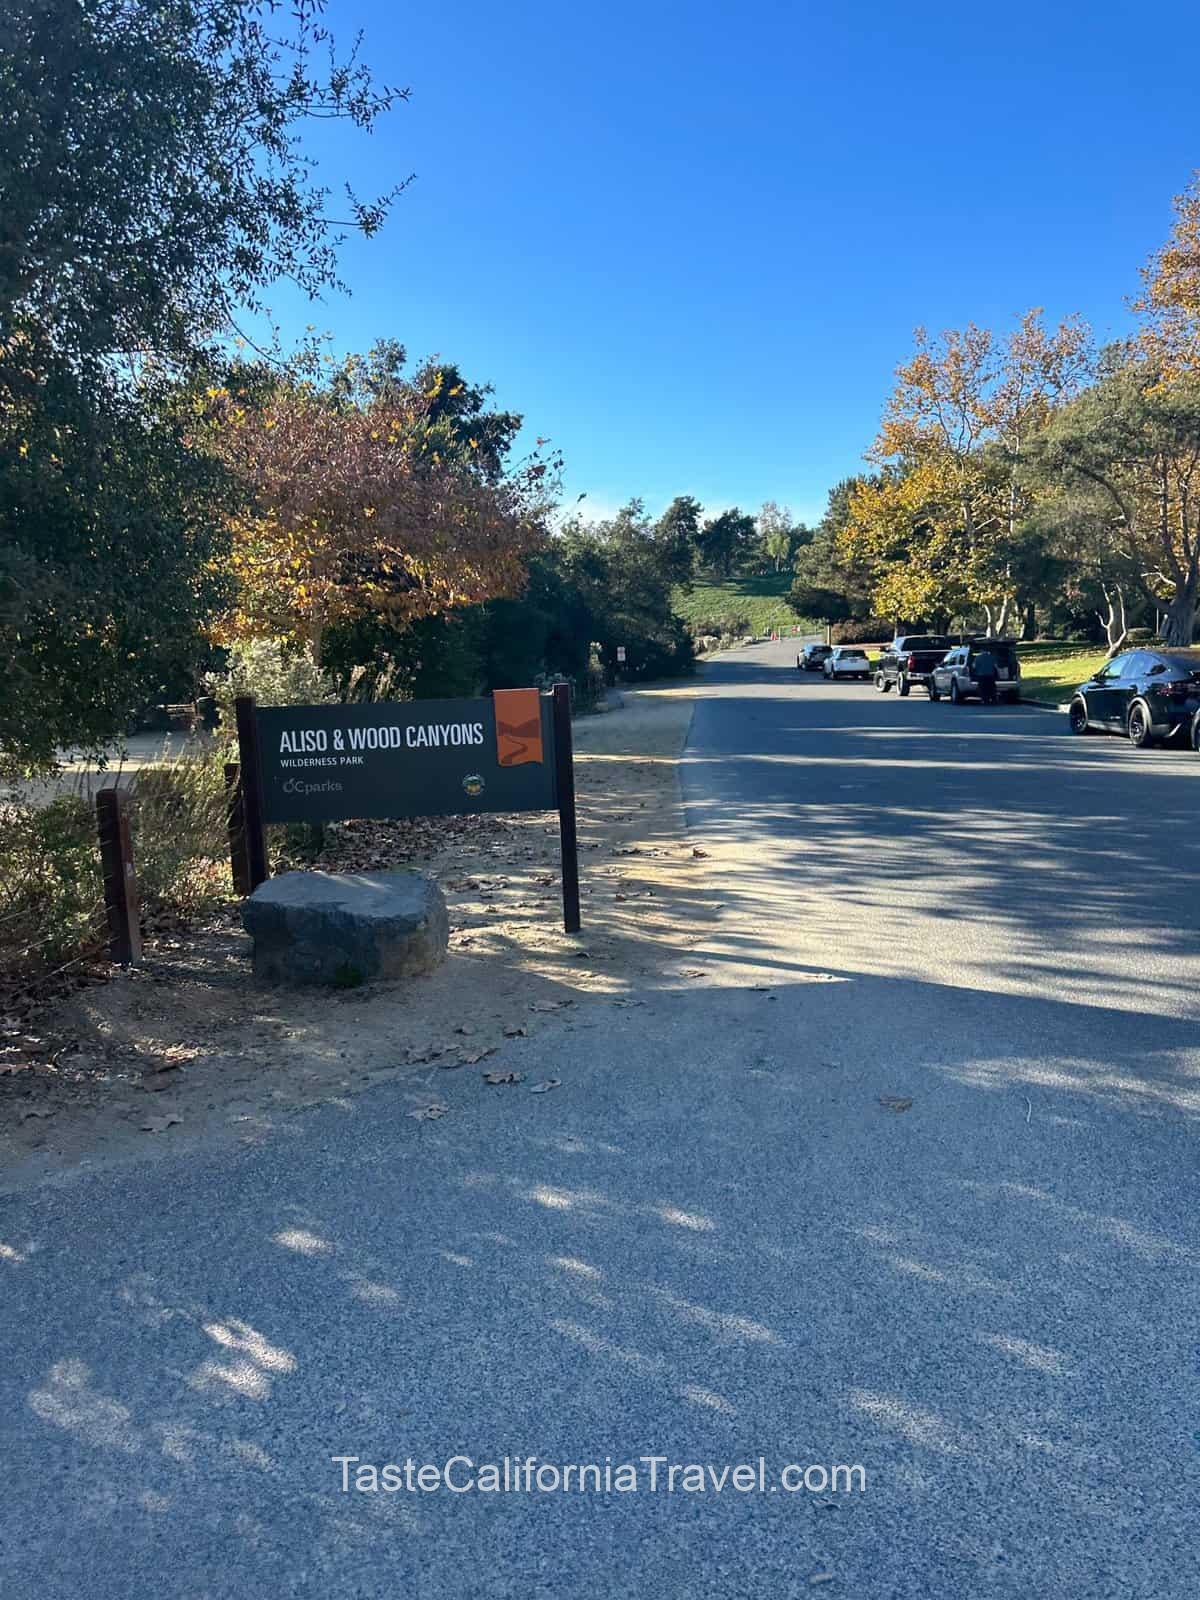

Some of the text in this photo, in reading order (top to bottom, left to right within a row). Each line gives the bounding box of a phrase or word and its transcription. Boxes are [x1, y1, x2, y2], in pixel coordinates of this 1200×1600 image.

[280, 723, 484, 753] ALISO & WOOD CANYONS
[280, 755, 364, 768] WILDERNESS PARK
[282, 778, 343, 795] OCparks
